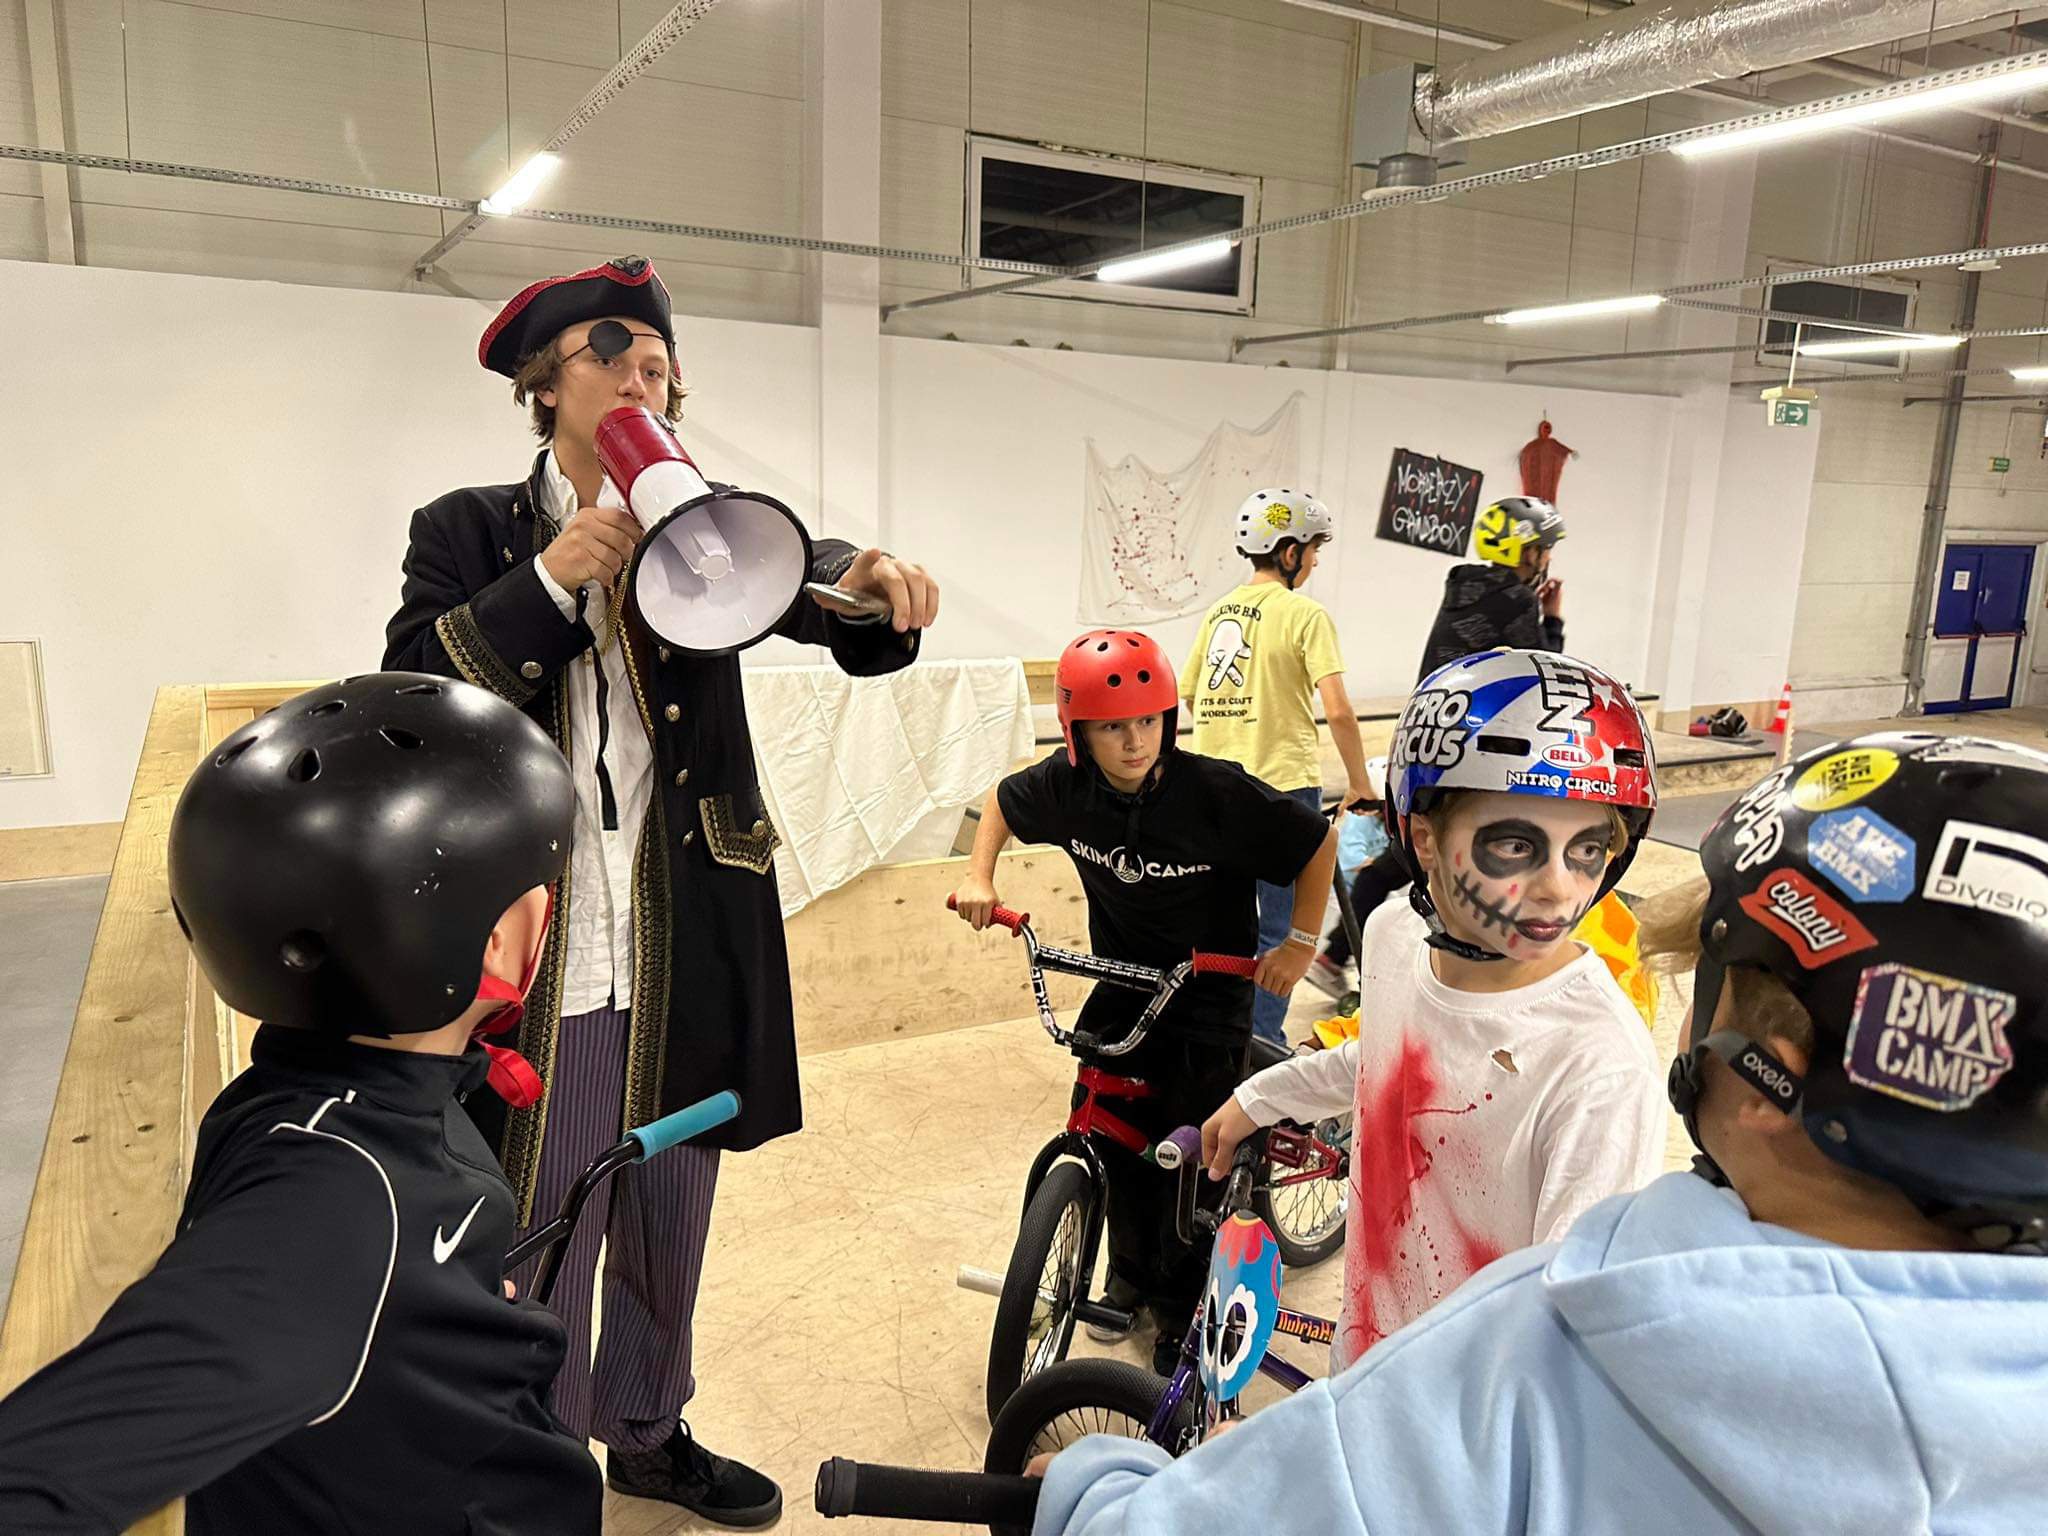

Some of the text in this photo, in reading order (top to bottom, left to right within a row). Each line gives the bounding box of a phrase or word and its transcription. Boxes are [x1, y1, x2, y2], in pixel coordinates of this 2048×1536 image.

[1550, 749, 1586, 763] BELL
[1508, 772, 1617, 796] NITRO CIRCUS
[1071, 838, 1211, 878] SKIM CAMP
[1815, 840, 1881, 896] BMX
[1770, 881, 1847, 951] colony
[1885, 973, 2006, 1064] BMX
[1743, 1052, 1793, 1098] oxelo
[1876, 1027, 1991, 1096] CAMP
